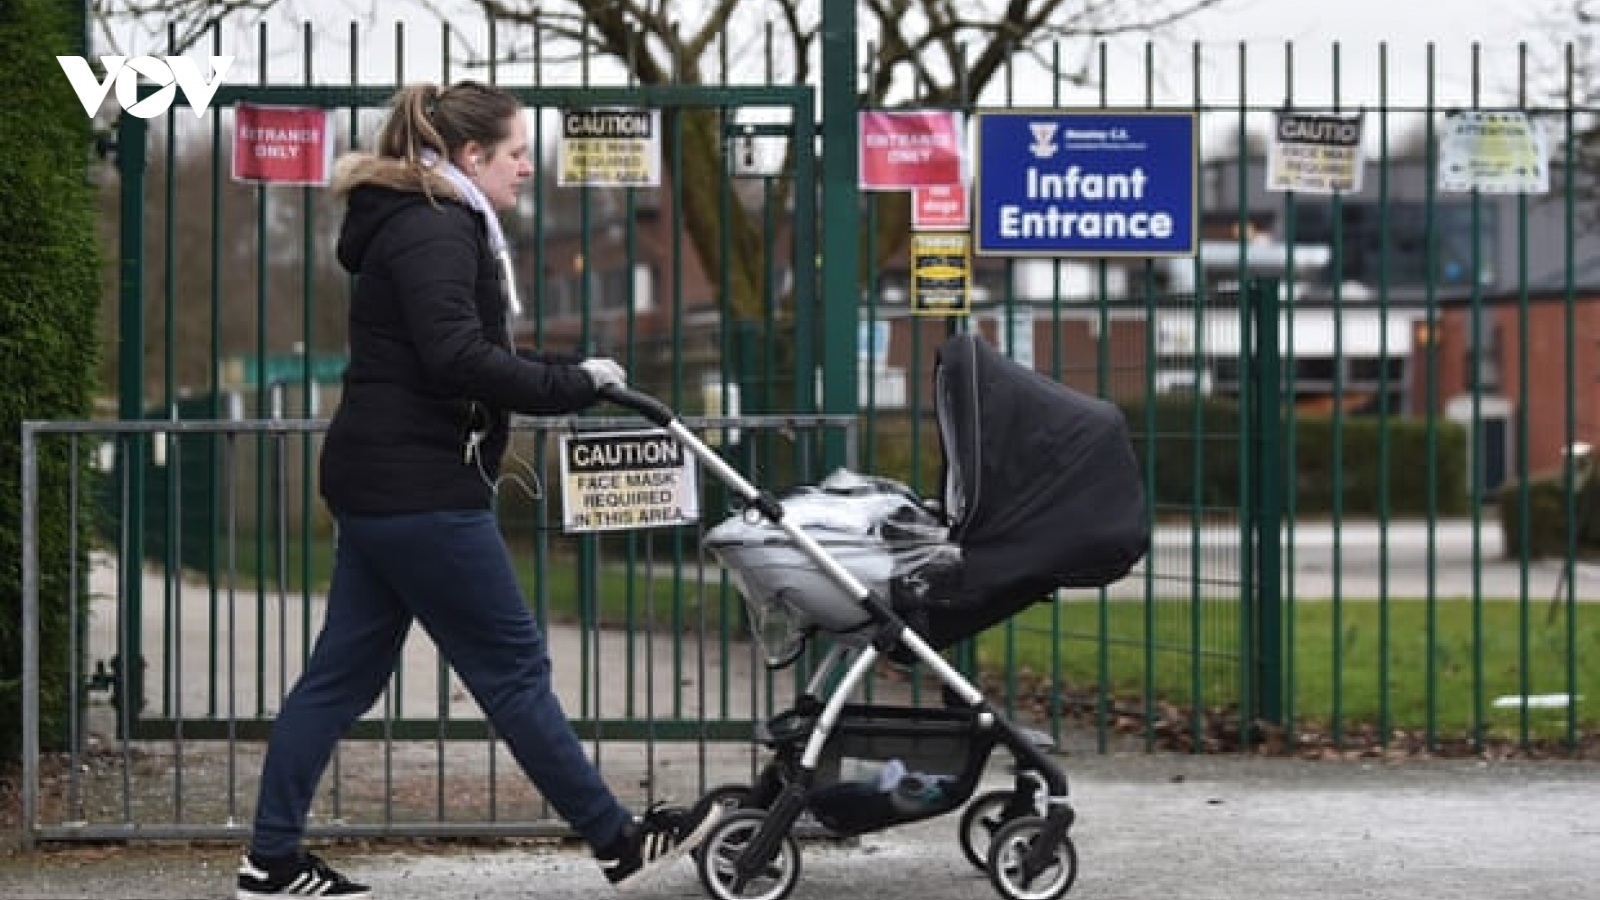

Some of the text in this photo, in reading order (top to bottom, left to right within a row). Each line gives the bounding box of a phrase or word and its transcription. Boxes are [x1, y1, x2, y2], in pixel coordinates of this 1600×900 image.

[567, 115, 648, 134] CAUTION
[1281, 119, 1356, 144] CAUTIO
[254, 144, 299, 158] ONLY
[1026, 165, 1148, 200] Infant
[999, 204, 1174, 239] Entrance
[573, 441, 678, 466] CAUTION
[577, 472, 679, 491] FACE MASK
[582, 490, 673, 508] REQUIRED
[593, 510, 632, 526] THIS
[638, 507, 684, 523] AREA
